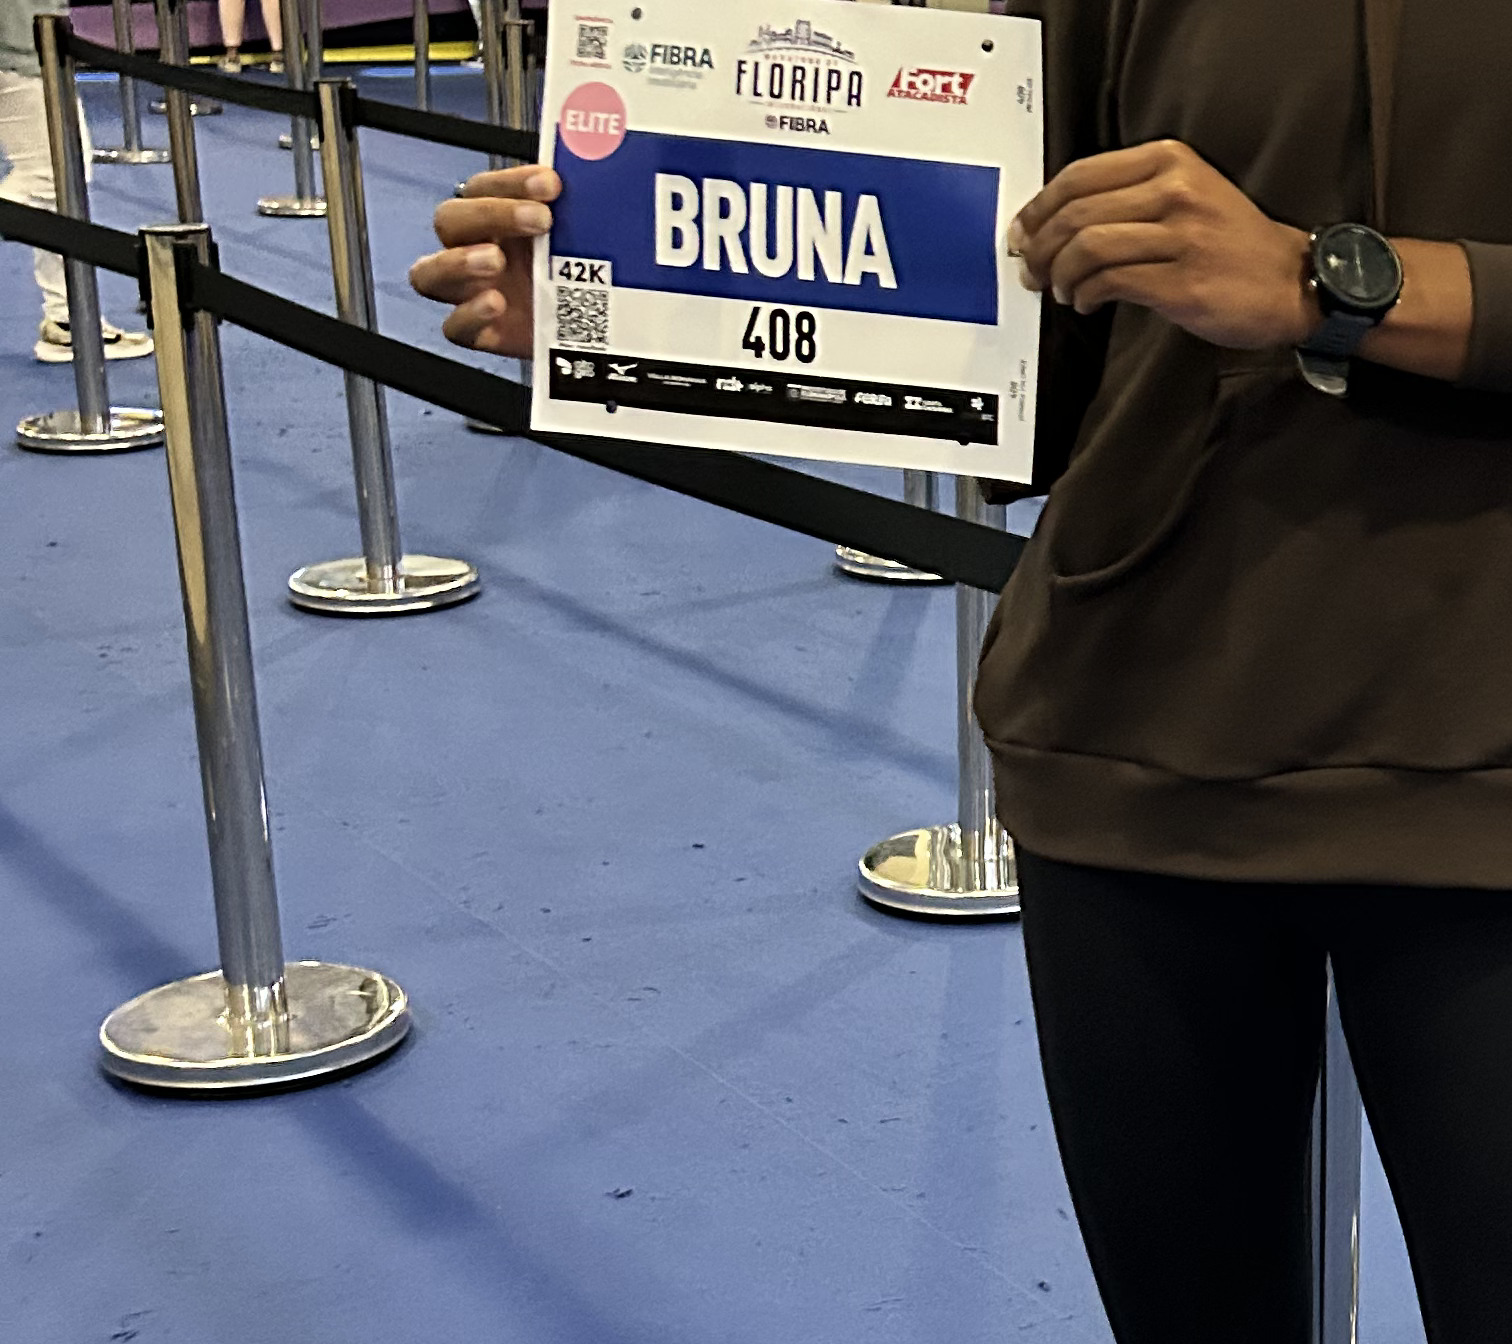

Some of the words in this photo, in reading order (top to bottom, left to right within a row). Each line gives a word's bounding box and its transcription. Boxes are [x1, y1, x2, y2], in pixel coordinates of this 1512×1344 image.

[650, 43, 714, 69] FIBRA
[736, 59, 864, 107] FLORIPA
[900, 67, 965, 96] Fort
[566, 109, 621, 135] ELITE
[779, 116, 830, 135] FIBRA
[654, 172, 897, 289] BRUNA
[558, 260, 606, 284] 42K
[741, 306, 818, 364] 408
